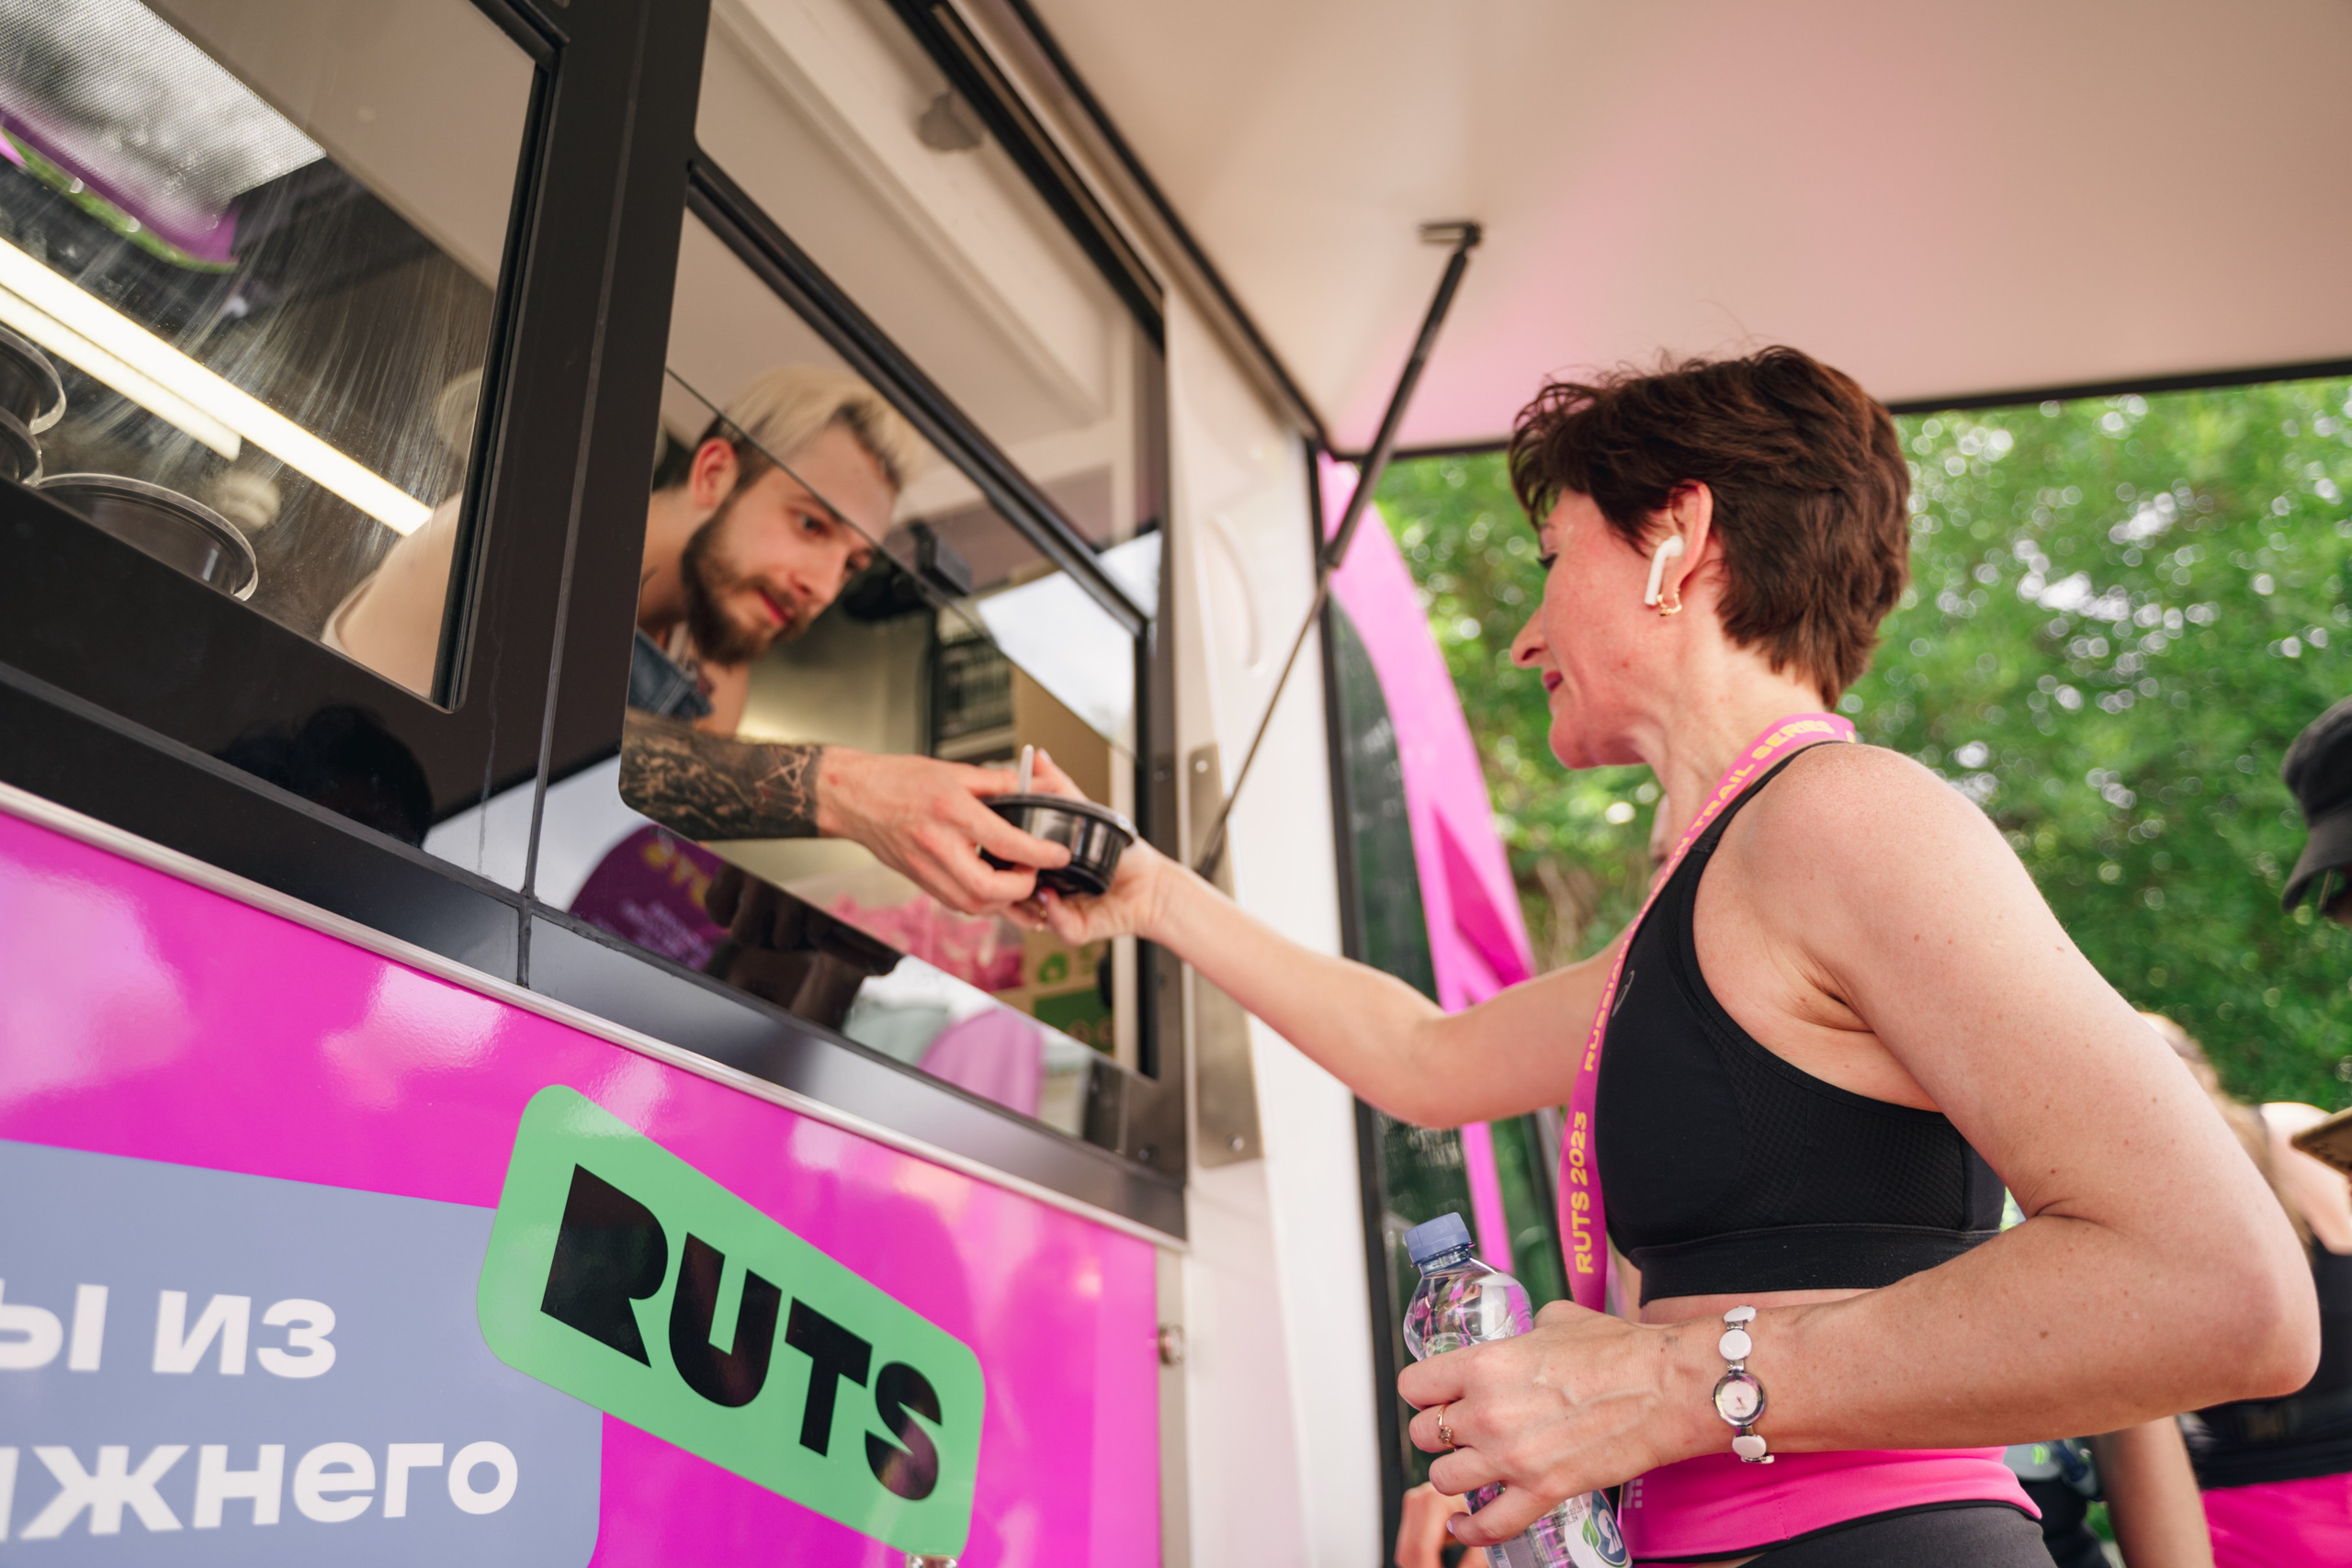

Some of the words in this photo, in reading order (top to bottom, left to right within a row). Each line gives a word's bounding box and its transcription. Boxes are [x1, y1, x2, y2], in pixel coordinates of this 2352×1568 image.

[1584, 938, 1630, 1072] RUSSIAN
[1690, 763, 1756, 832] TRAIL
[1751, 720, 1836, 761] SERIES
[1569, 1111, 1589, 1186] 2023
[1571, 1190, 1594, 1275] RUTS
[152, 1289, 337, 1379] из
[540, 1163, 944, 1502] RUTS
